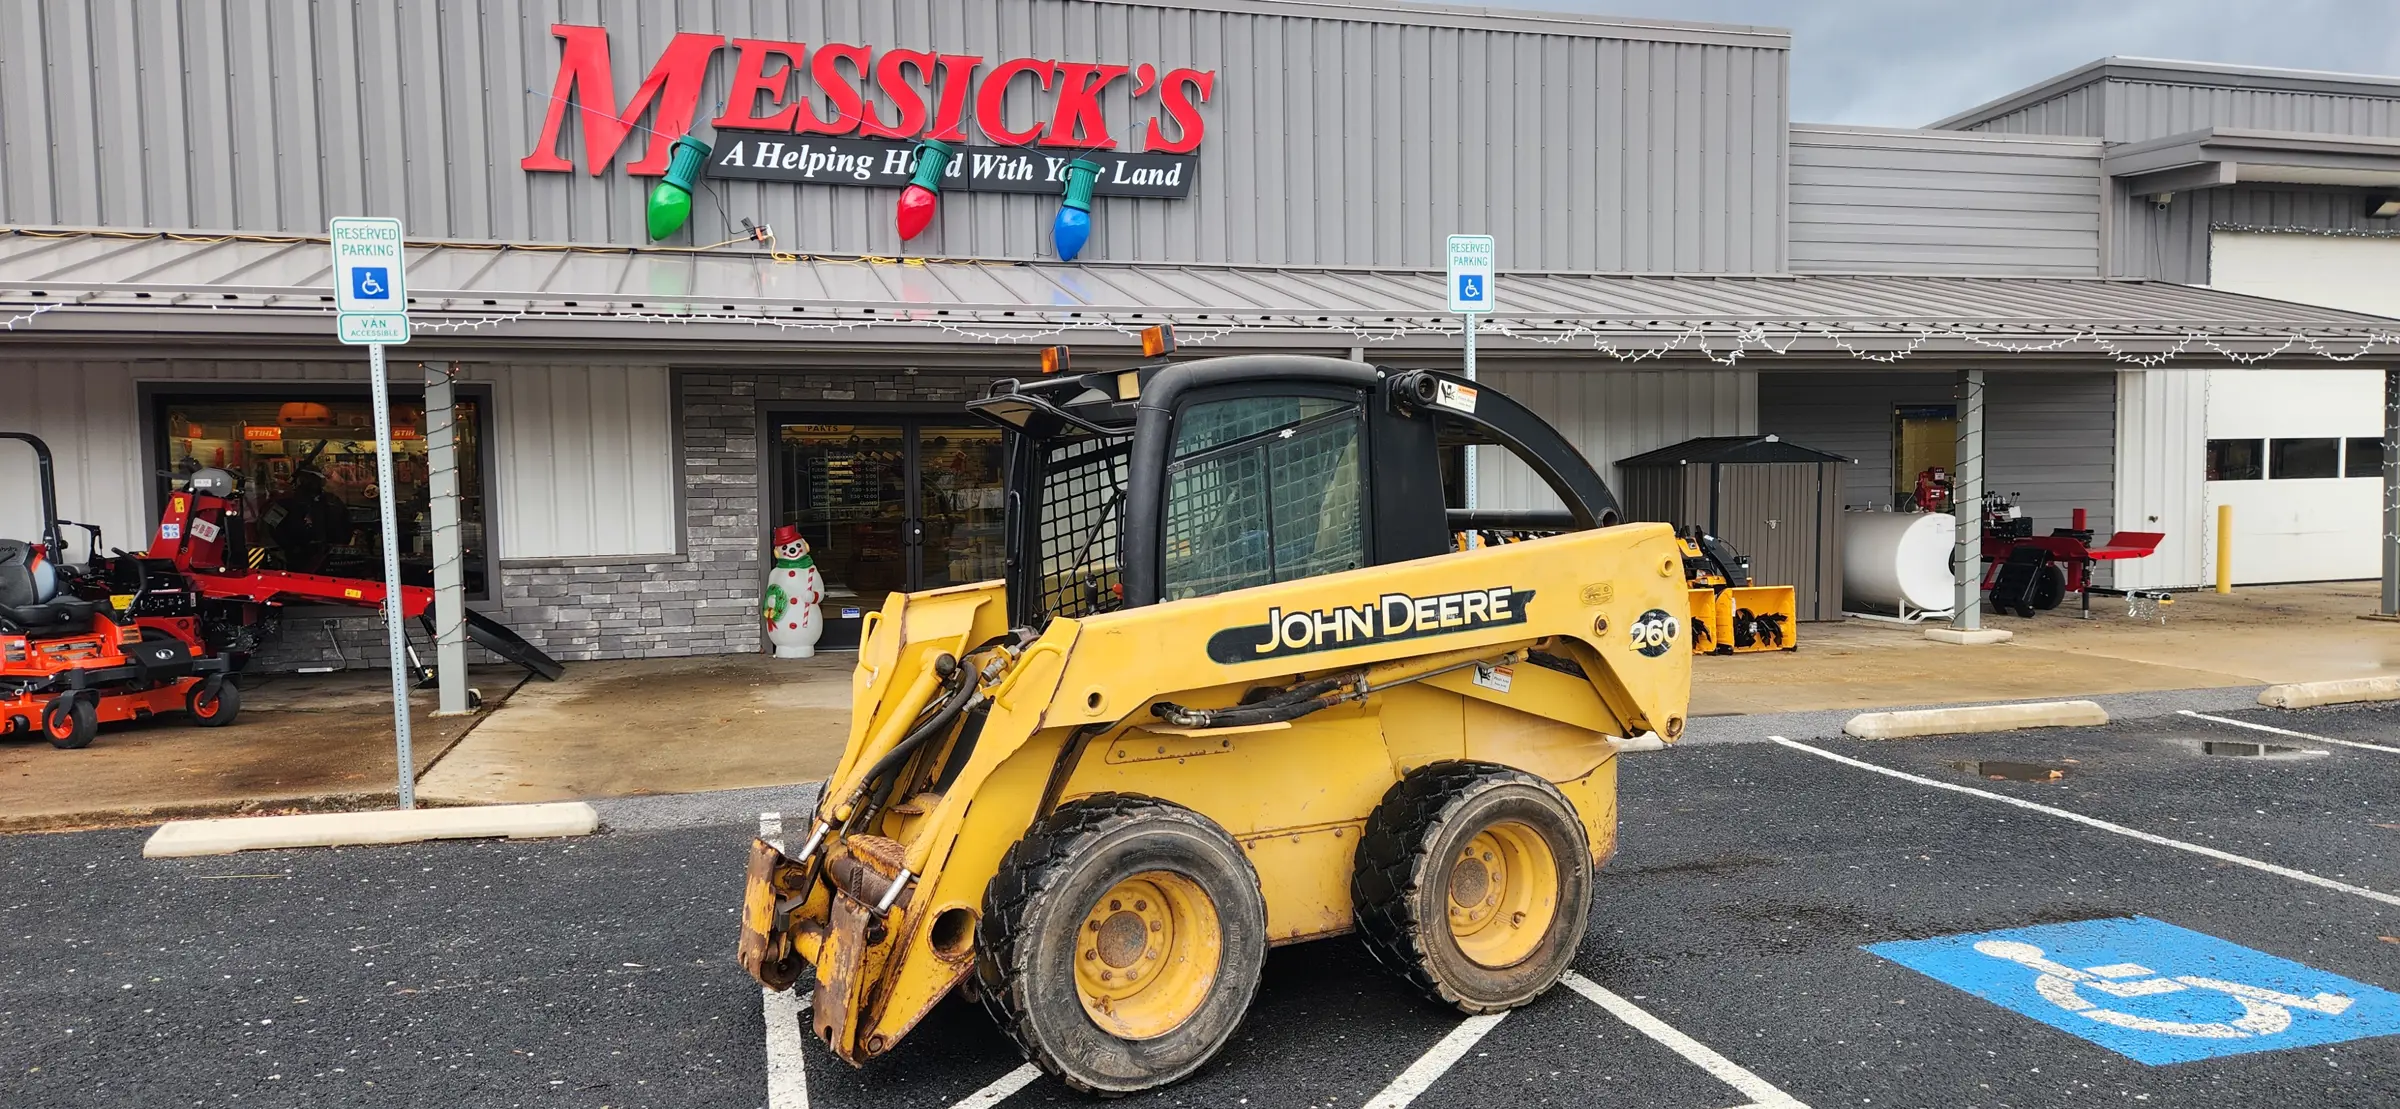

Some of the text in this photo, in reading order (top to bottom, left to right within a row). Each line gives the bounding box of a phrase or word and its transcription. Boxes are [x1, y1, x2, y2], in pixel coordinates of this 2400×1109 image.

[720, 140, 1183, 187] A Helping Hd With Yor Land
[336, 227, 397, 240] RESERVED
[341, 244, 394, 257] PARKING
[1450, 243, 1491, 254] RESERVED
[1453, 256, 1488, 267] PARKING
[361, 319, 387, 328] VAN
[393, 429, 415, 437] STIH
[1255, 586, 1513, 654] JOHN DEERE
[1628, 616, 1680, 652] 260
